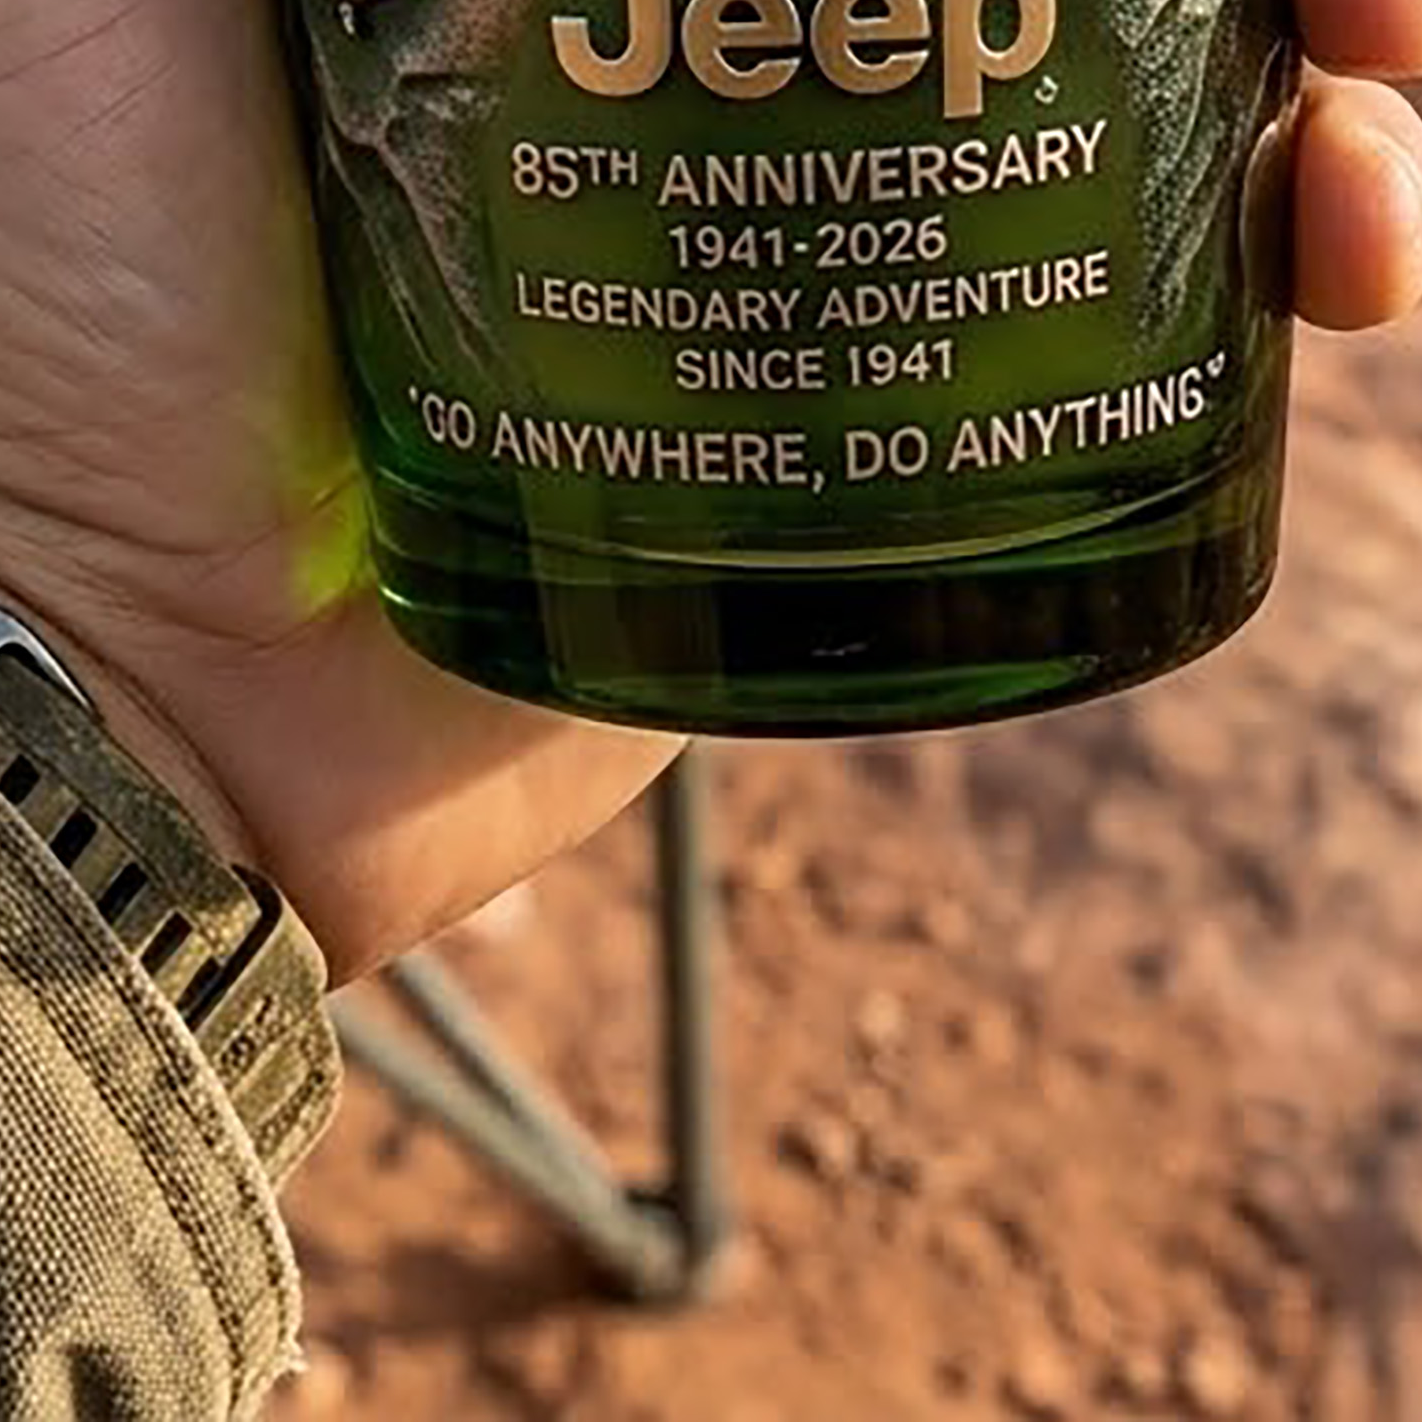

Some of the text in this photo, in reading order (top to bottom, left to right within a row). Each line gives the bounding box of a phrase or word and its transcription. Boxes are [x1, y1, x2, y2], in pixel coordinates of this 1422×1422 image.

[510, 119, 1108, 208] 85TH ANNIVERSARY
[668, 214, 948, 269] 1941-2026
[516, 251, 1110, 332] LEGENDARY ADVENTURE
[676, 339, 955, 390] SINCE 1941
[490, 410, 826, 494] ANYWHERE,
[845, 426, 929, 483] DO
